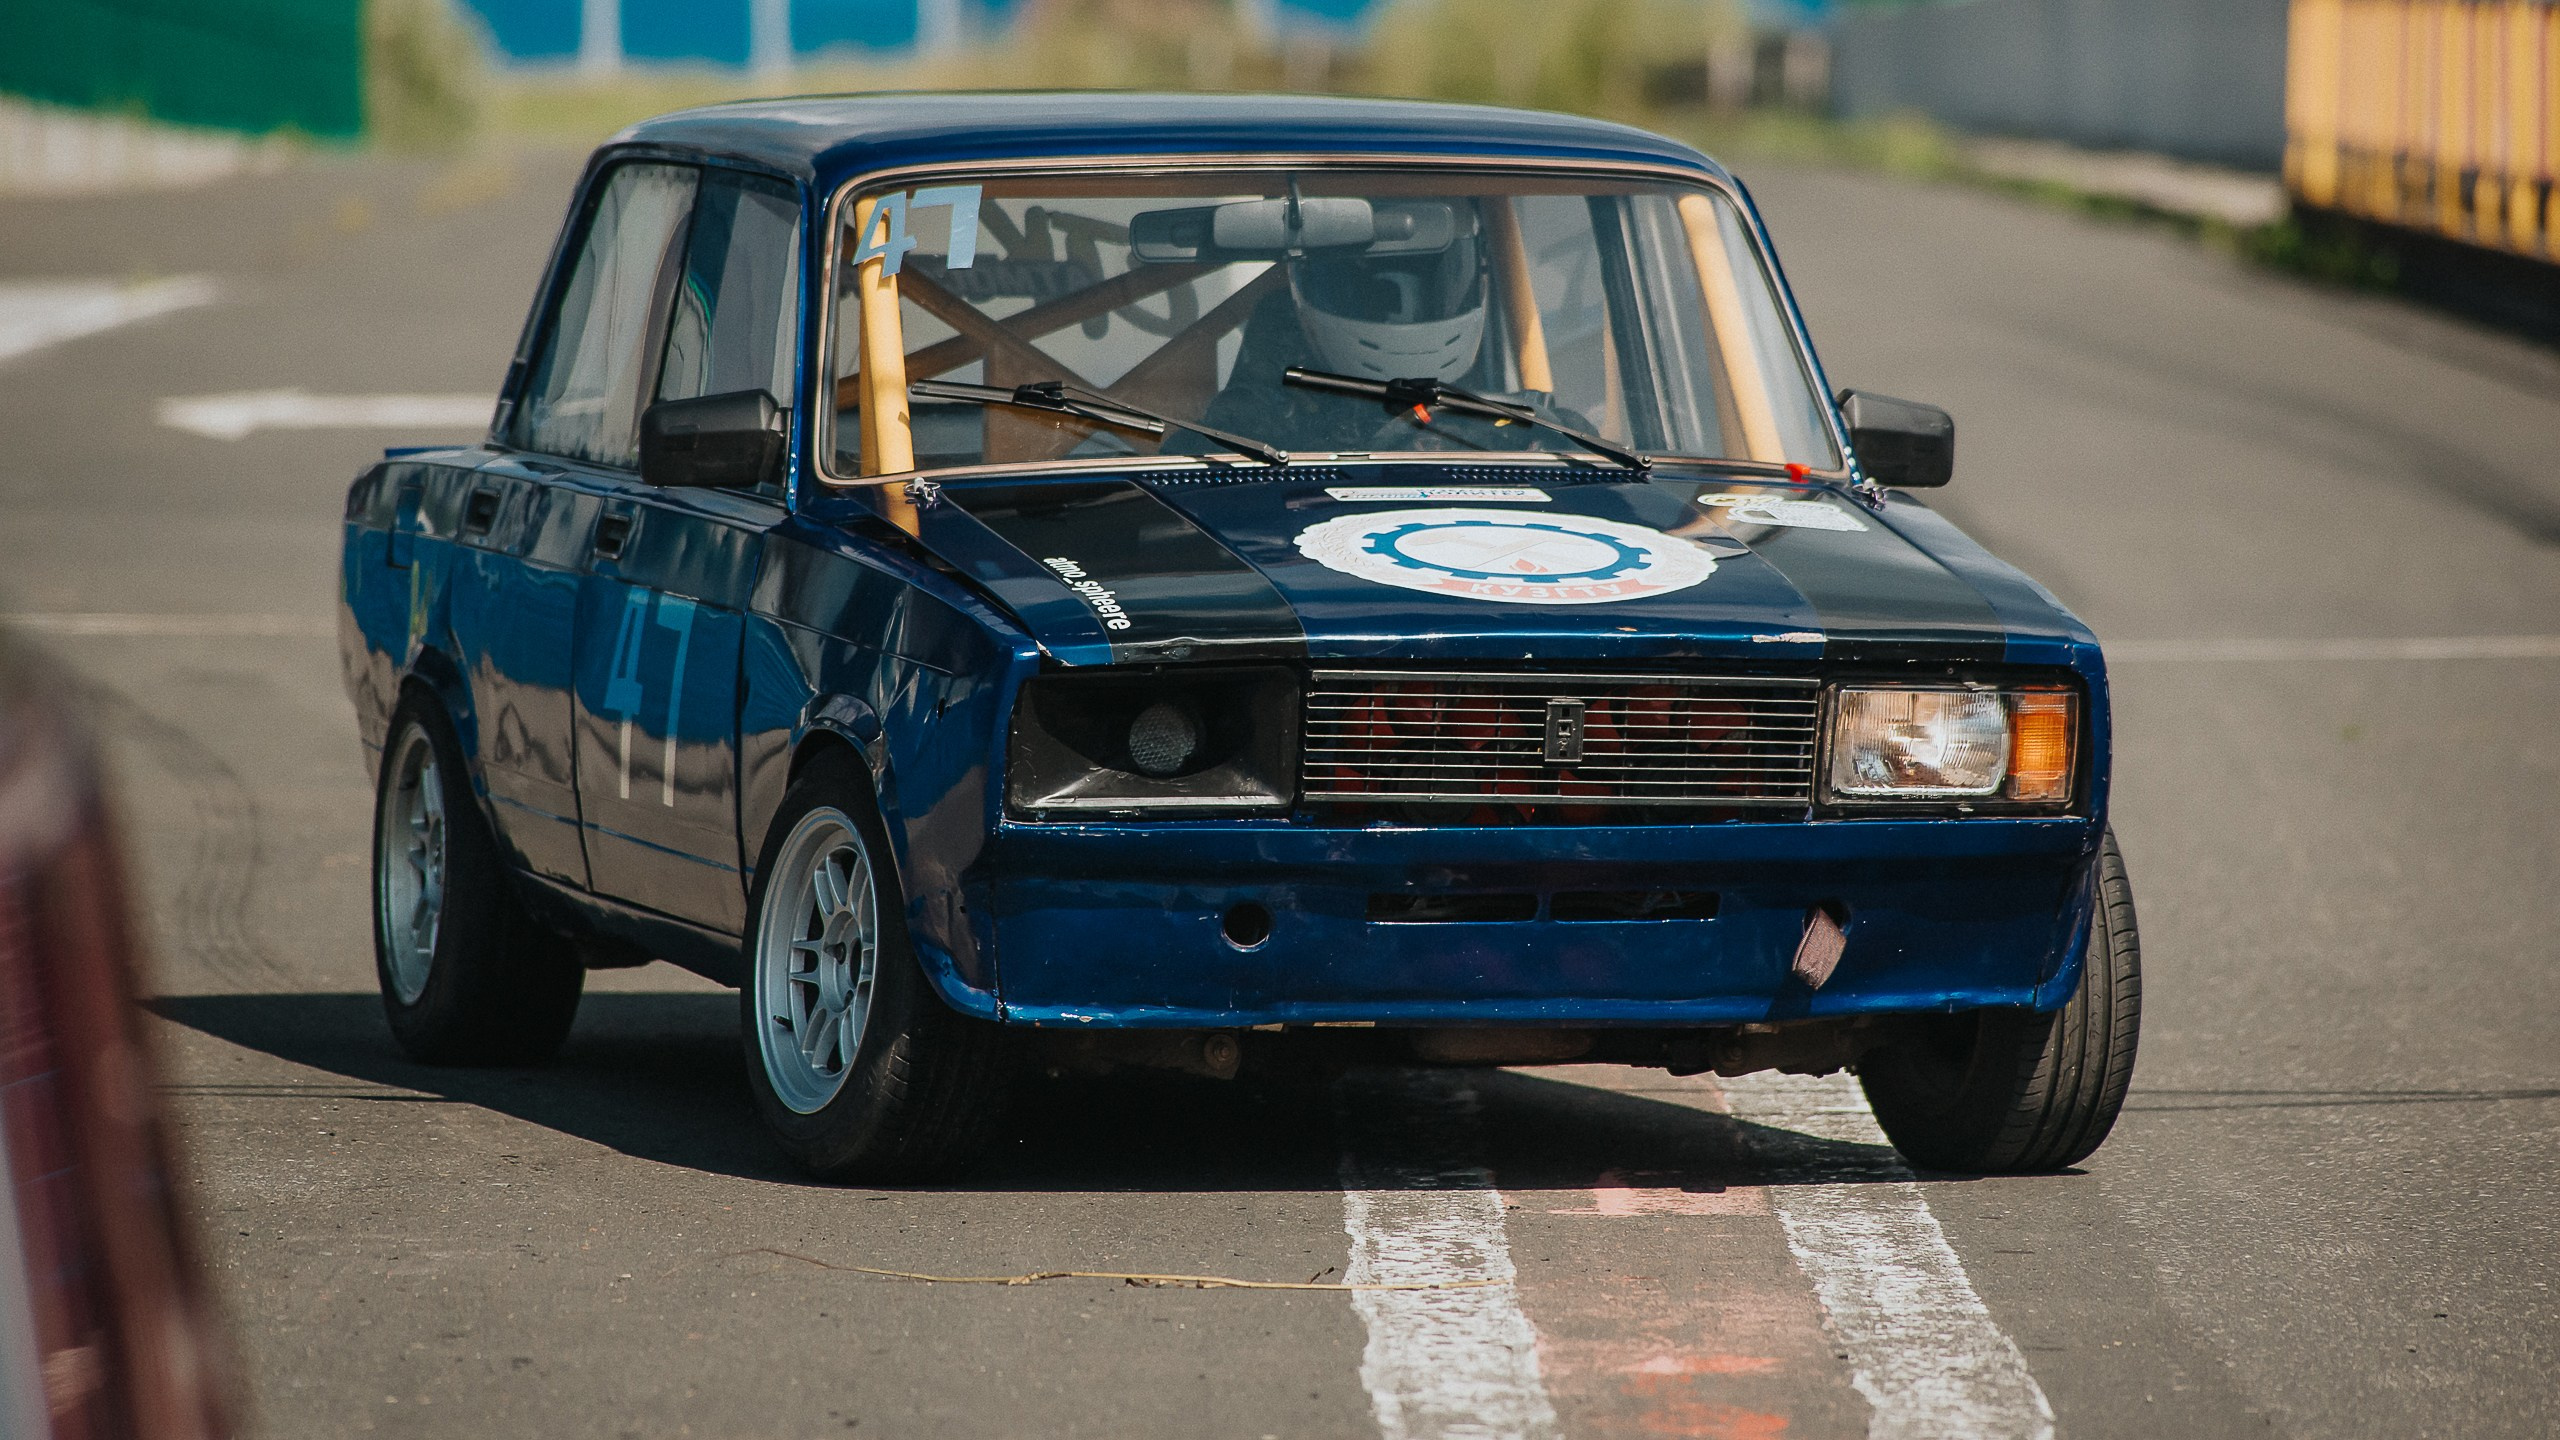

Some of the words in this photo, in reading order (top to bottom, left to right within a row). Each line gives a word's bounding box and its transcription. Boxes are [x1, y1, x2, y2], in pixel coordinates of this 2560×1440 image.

[852, 184, 982, 278] 47
[1470, 584, 1621, 597] КУЗГТУ
[603, 586, 698, 807] 47
